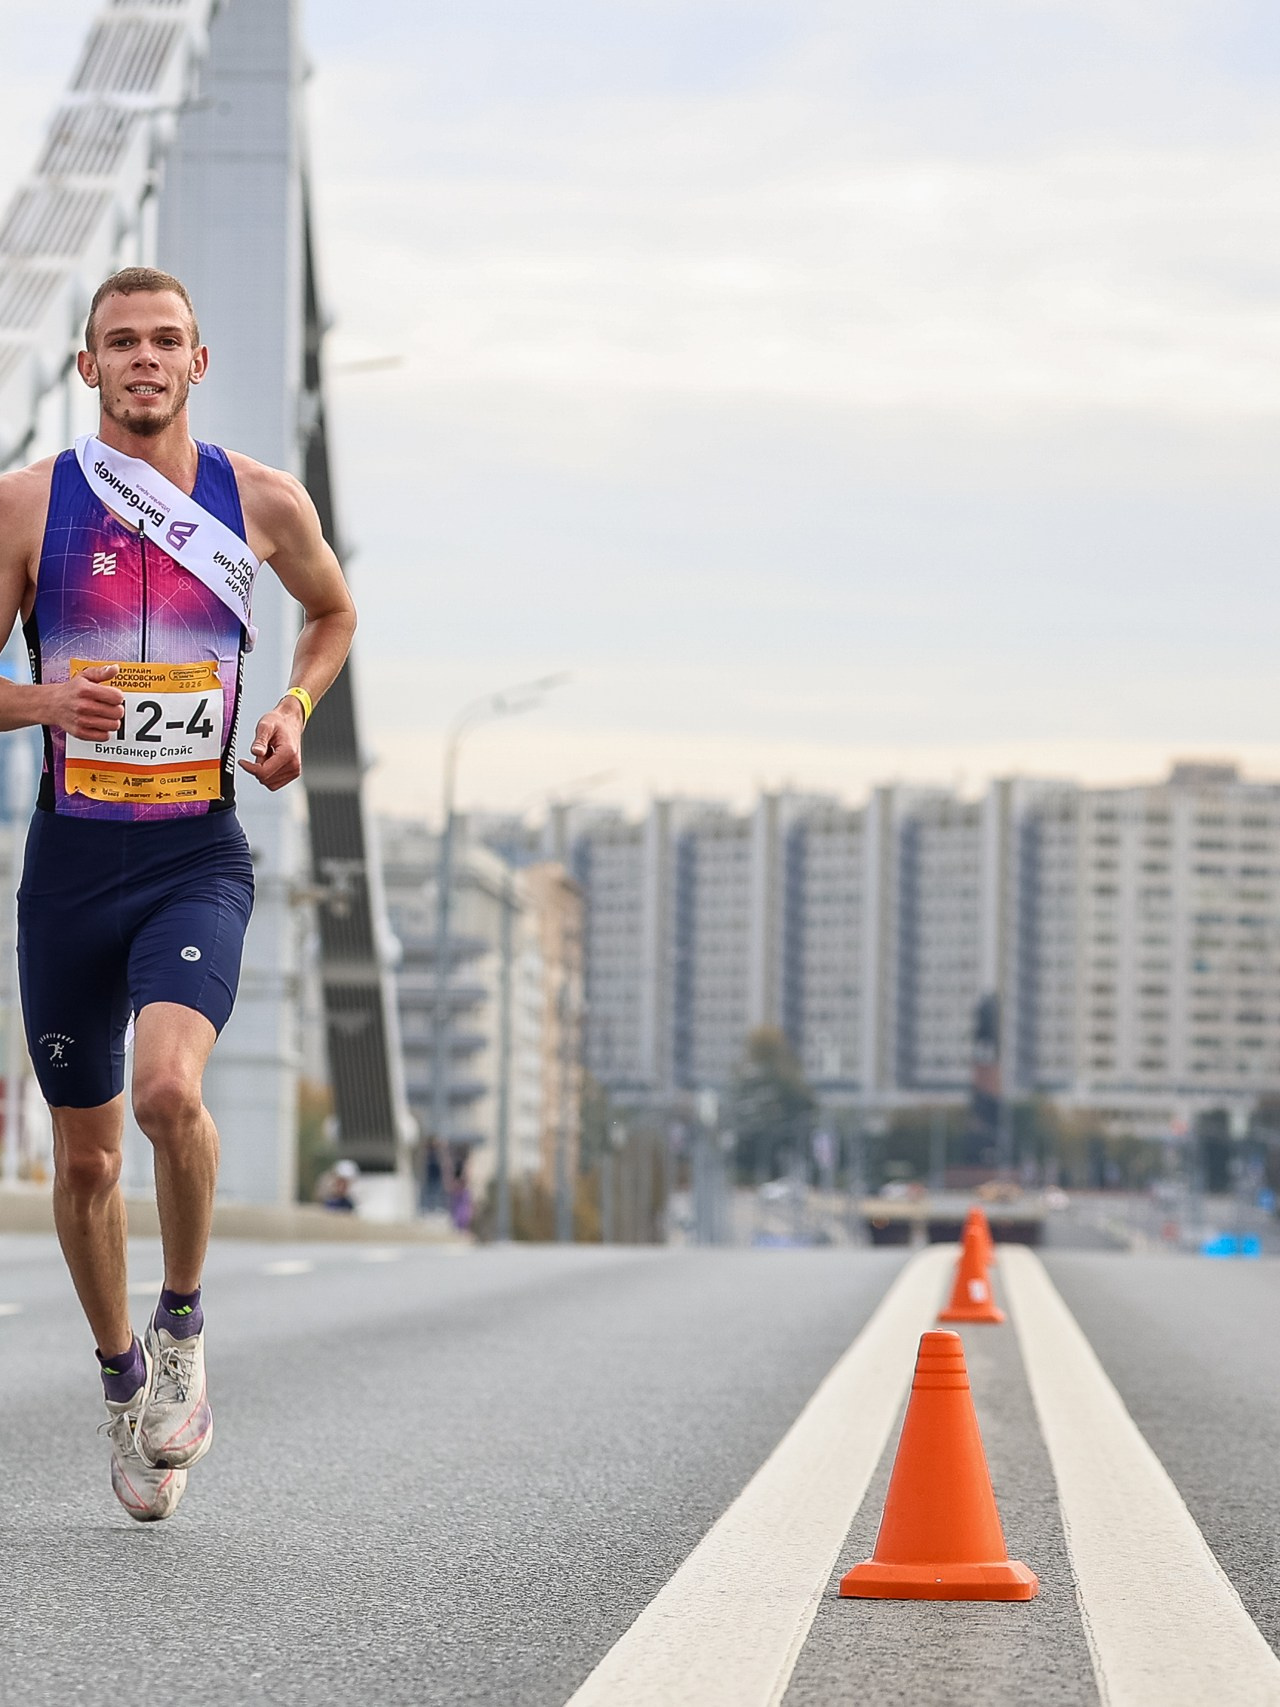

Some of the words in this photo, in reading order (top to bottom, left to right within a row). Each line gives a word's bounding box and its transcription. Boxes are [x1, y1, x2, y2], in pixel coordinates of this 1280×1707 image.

[94, 460, 165, 527] Битбанкер
[213, 551, 249, 592] ОВСКИЙ
[95, 743, 157, 759] Битбанкер
[160, 745, 193, 756] Спэйс
